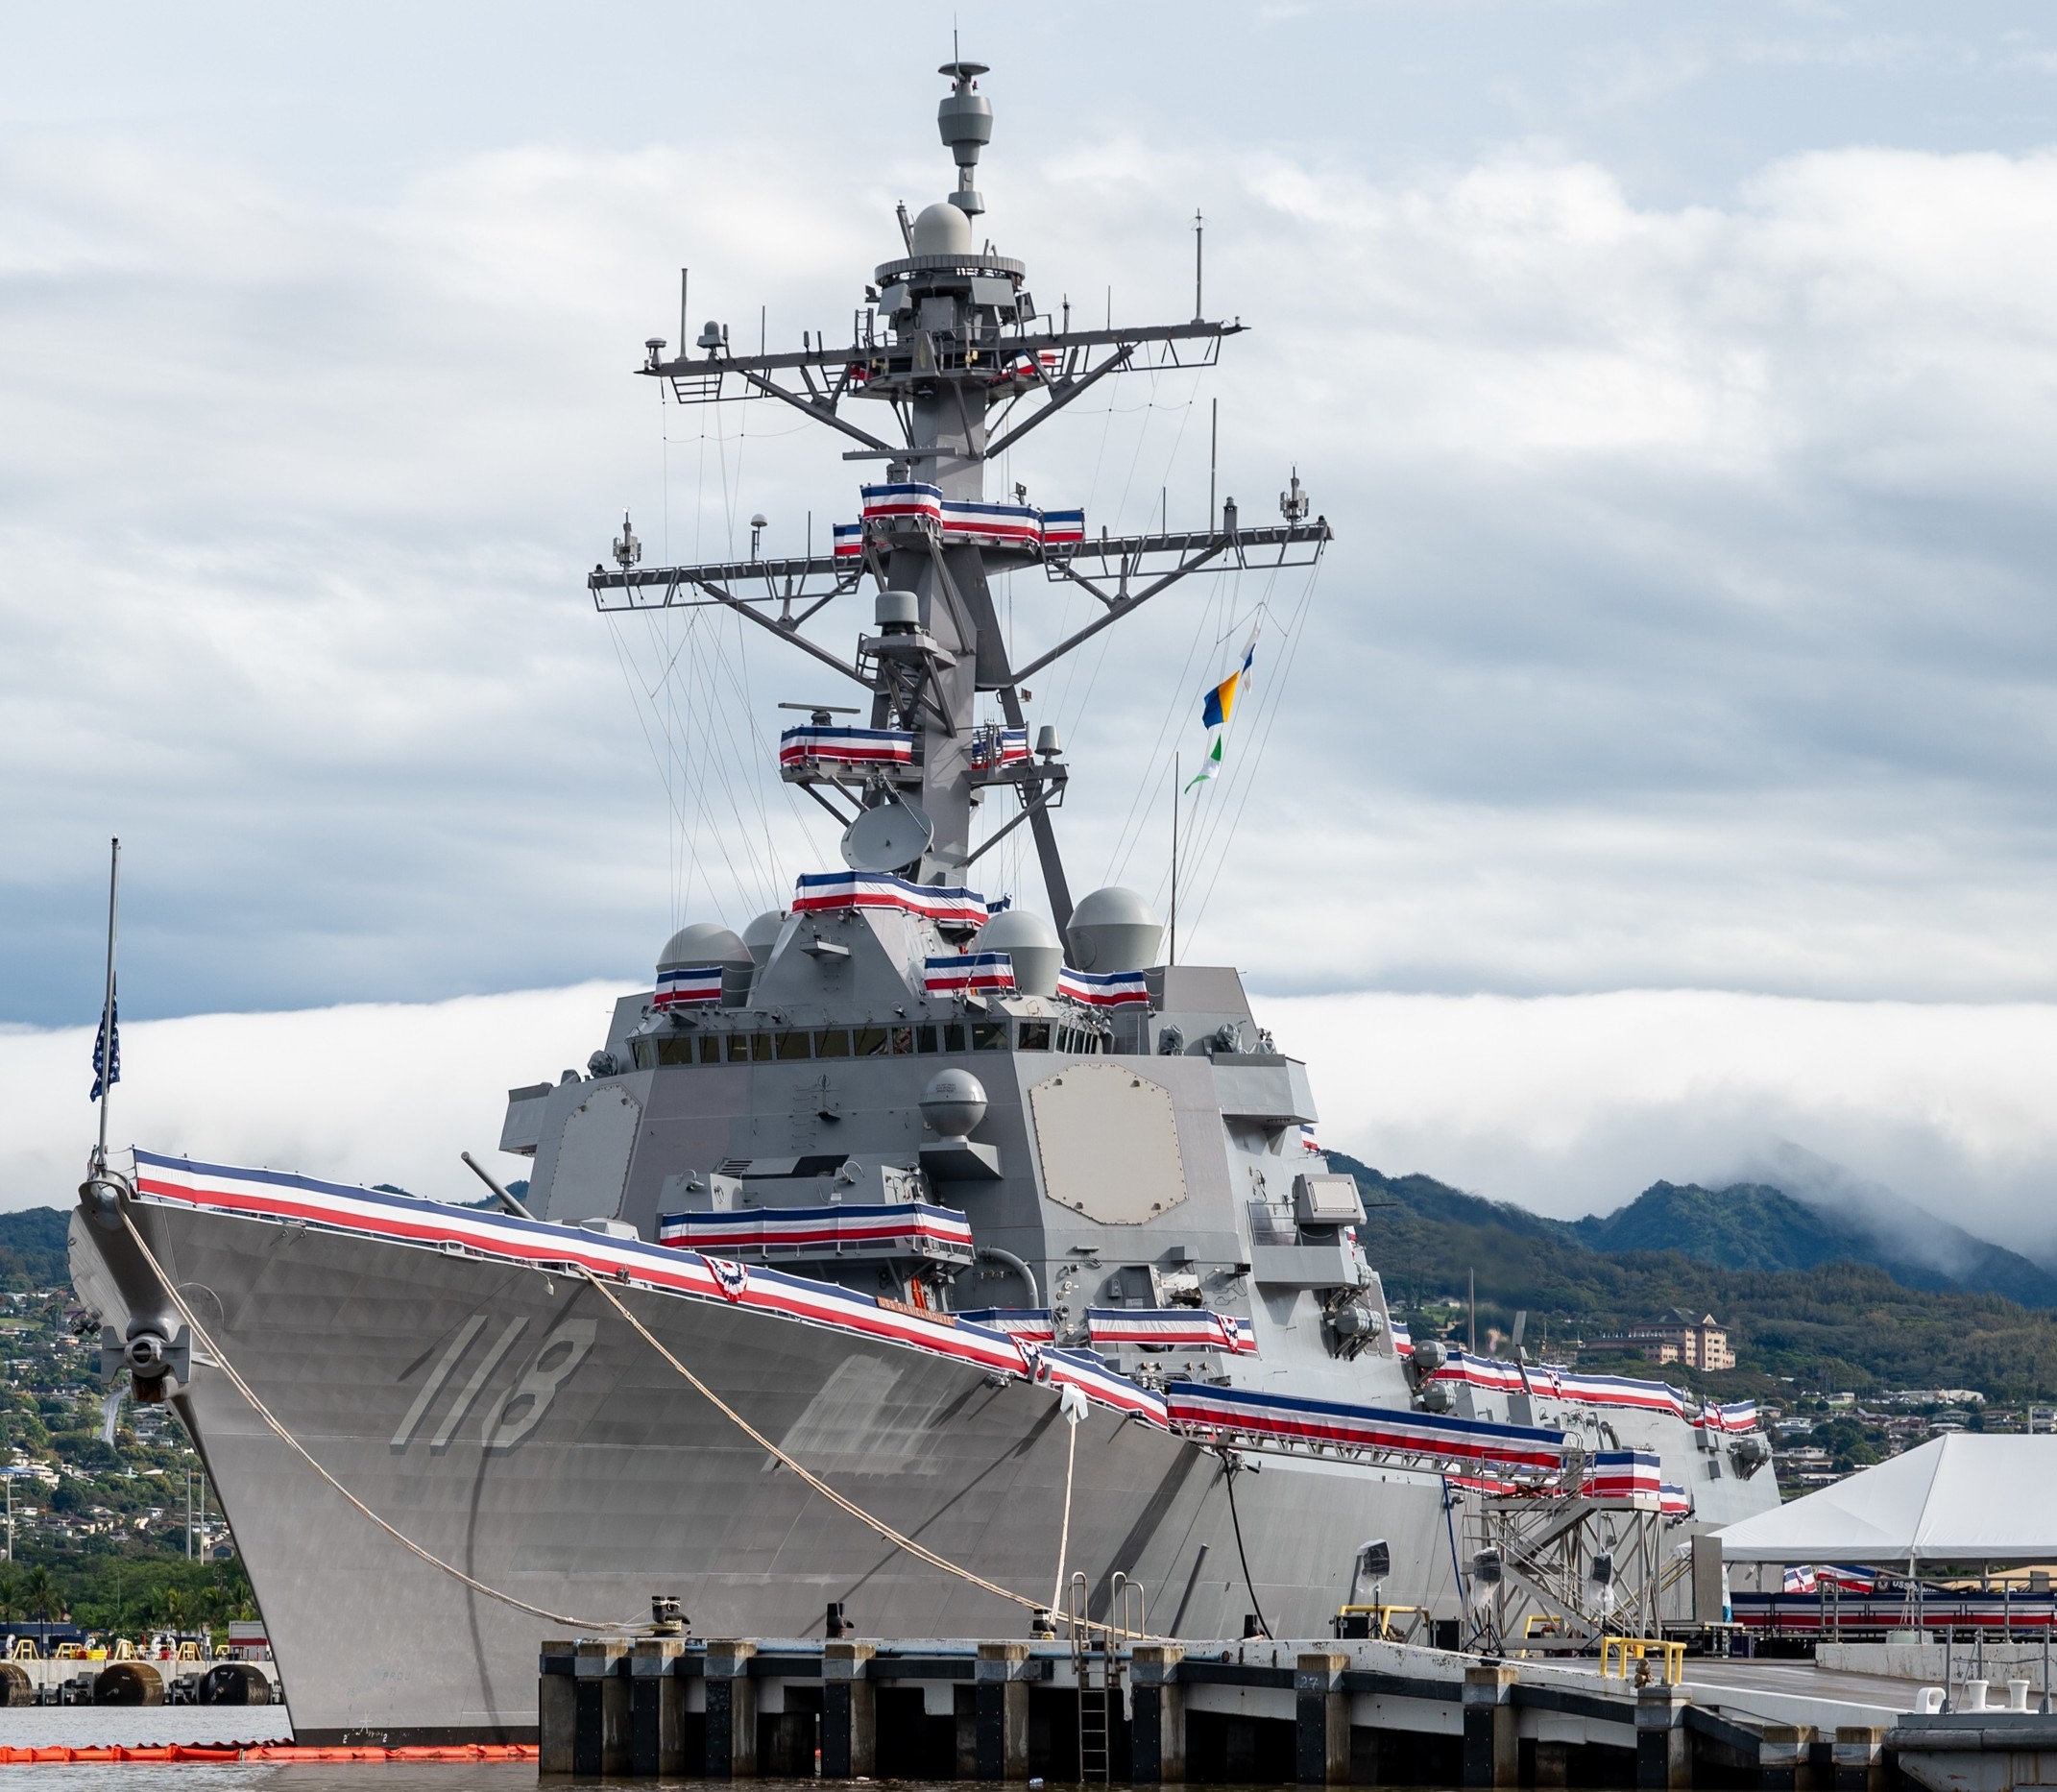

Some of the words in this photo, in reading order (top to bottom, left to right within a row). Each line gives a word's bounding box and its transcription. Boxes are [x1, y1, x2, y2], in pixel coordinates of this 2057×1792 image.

[880, 1297, 895, 1309] USS
[898, 1303, 925, 1318] DANIEL
[926, 1311, 953, 1325] INOUYE
[389, 1315, 598, 1458] 118
[1892, 1581, 1910, 1590] USS
[1299, 1675, 1319, 1690] 27
[343, 1734, 348, 1744] 2
[382, 1733, 388, 1743] 2
